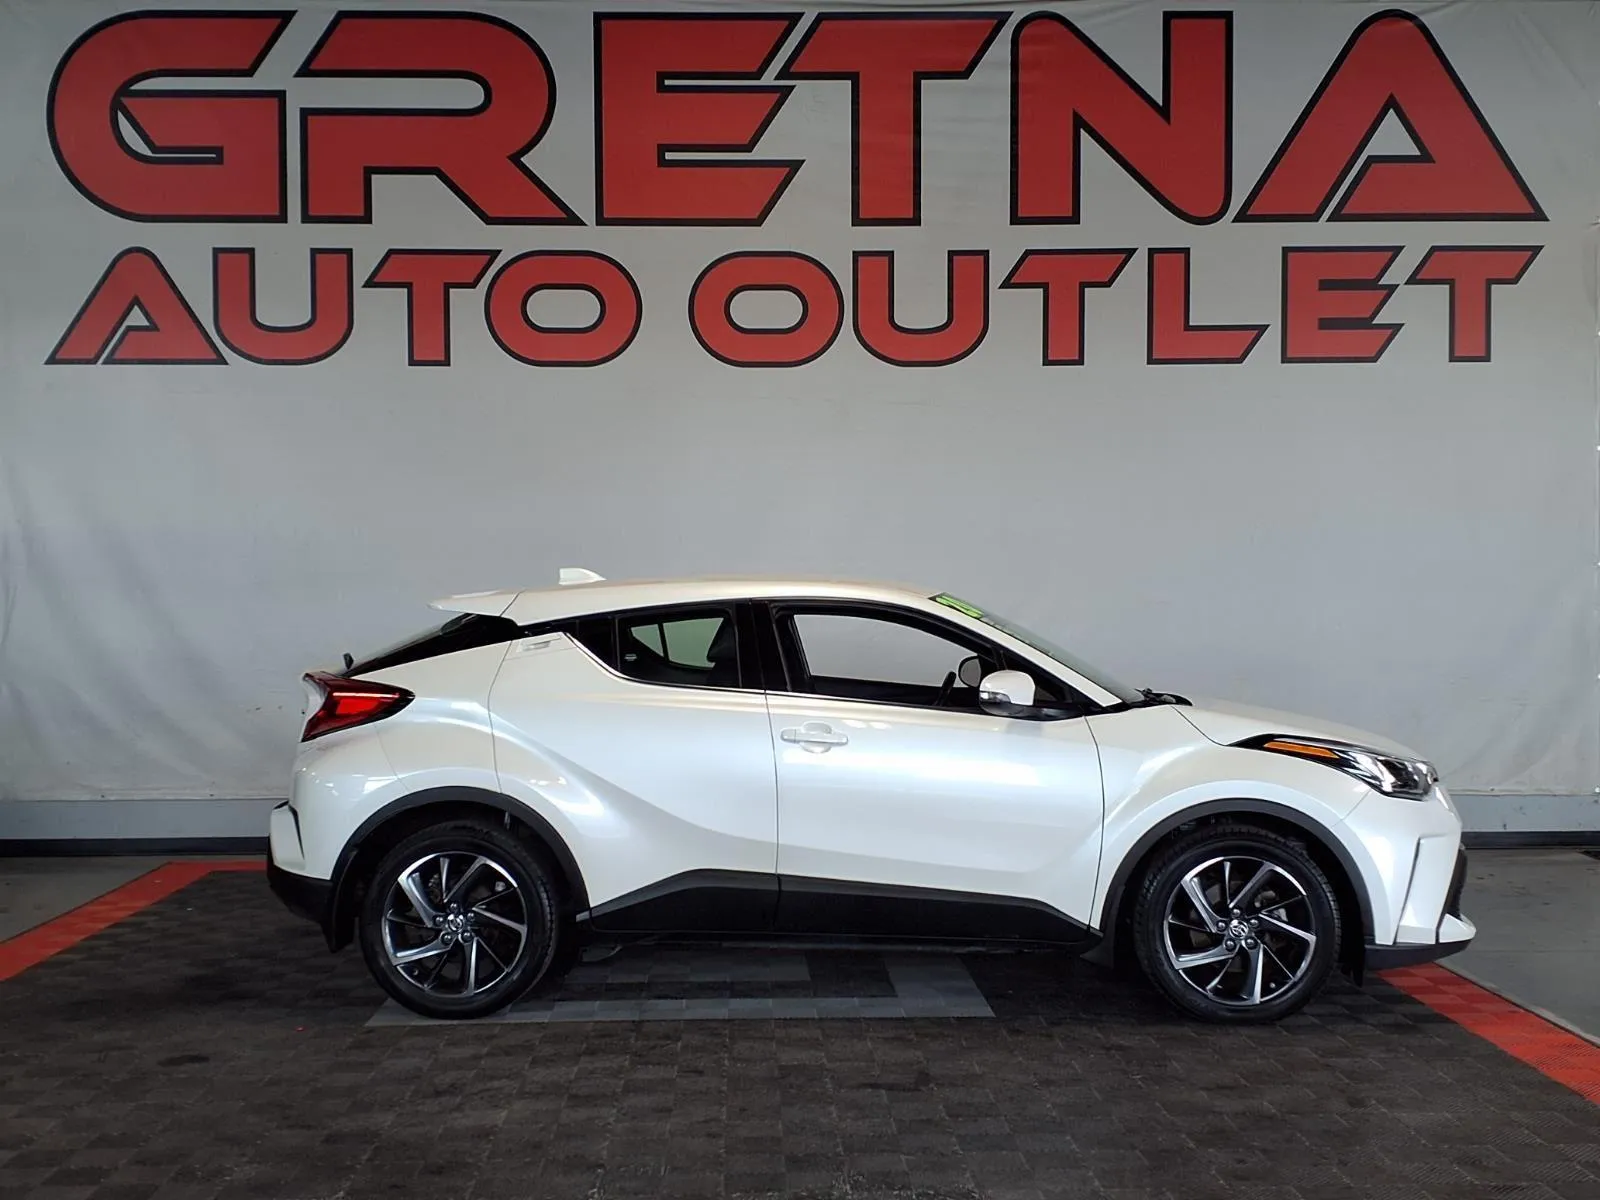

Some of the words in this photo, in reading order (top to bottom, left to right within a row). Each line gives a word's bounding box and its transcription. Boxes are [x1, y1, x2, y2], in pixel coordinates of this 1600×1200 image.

[46, 9, 1548, 225] GRETNA
[44, 246, 643, 366] AUTO
[688, 246, 1543, 366] OUTLET
